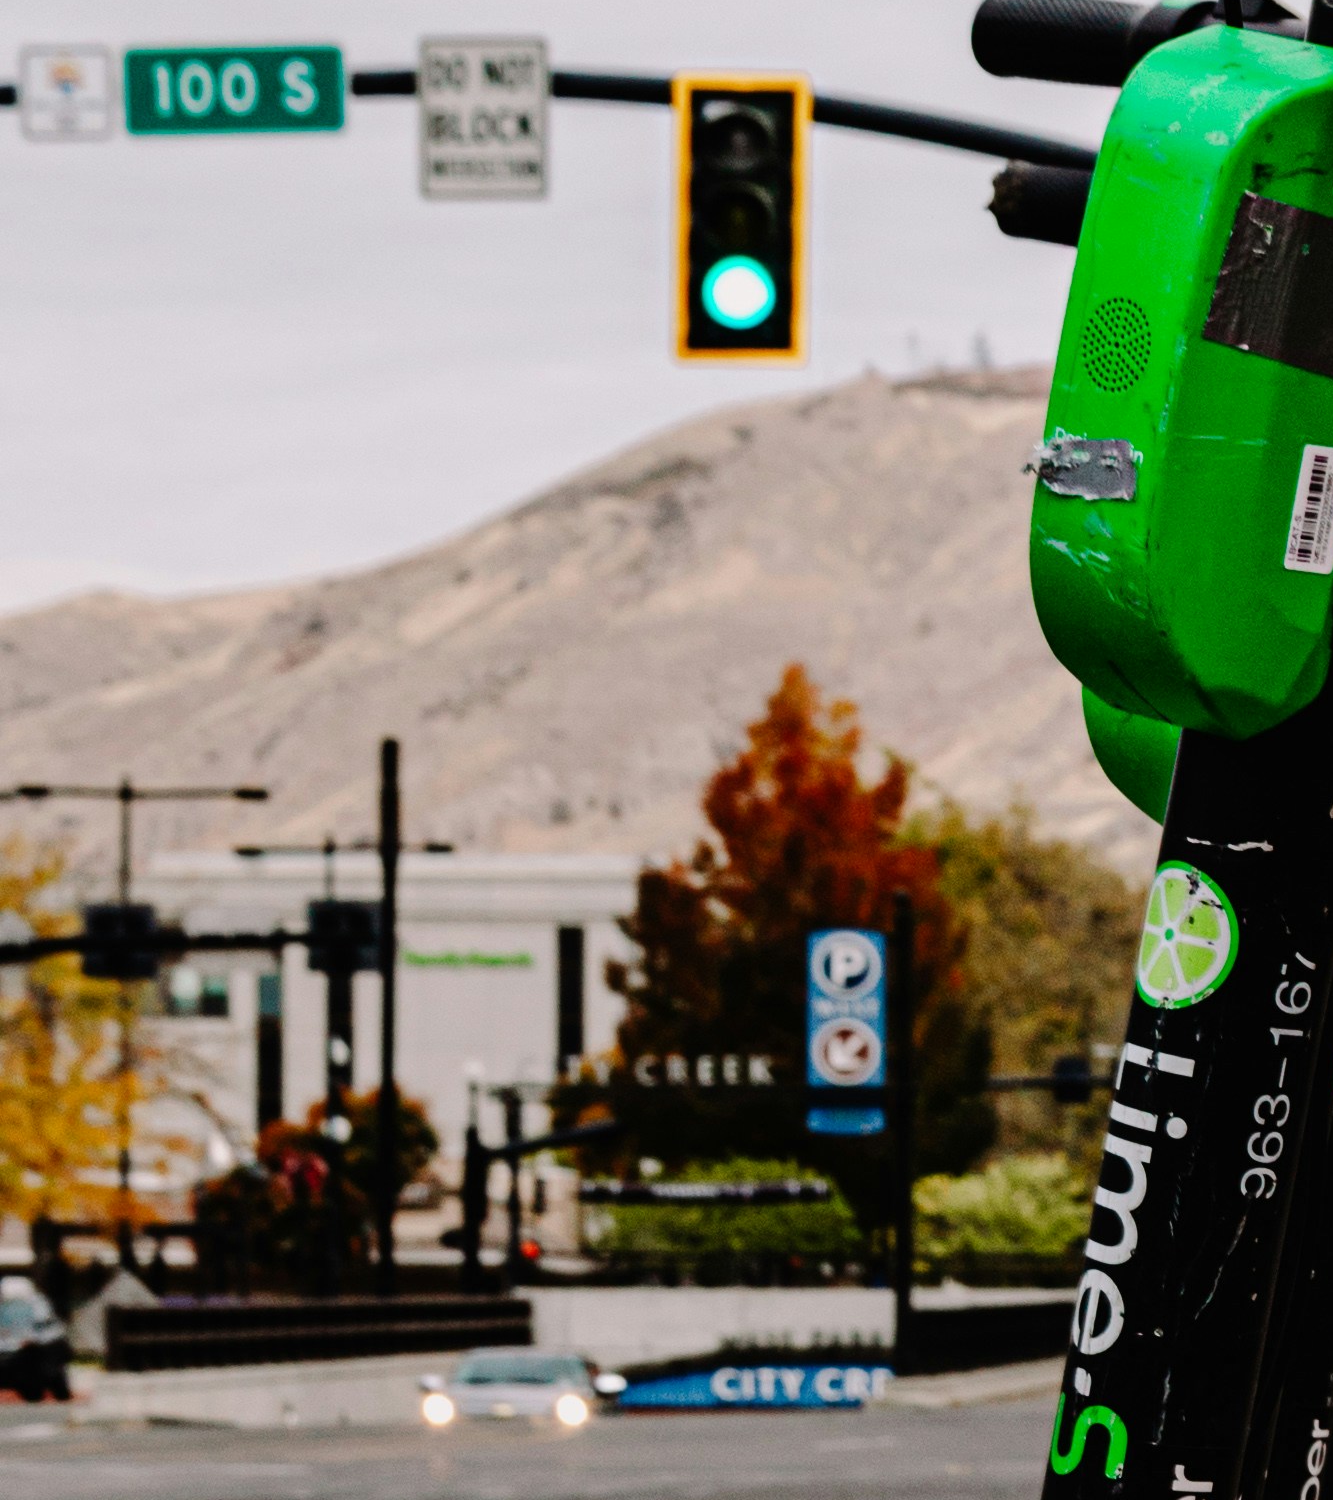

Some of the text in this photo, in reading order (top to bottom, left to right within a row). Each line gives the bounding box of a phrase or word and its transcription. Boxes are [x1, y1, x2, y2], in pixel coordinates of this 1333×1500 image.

[154, 59, 317, 115] 100 S
[1239, 951, 1318, 1200] 963-167
[709, 1366, 806, 1401] CITY
